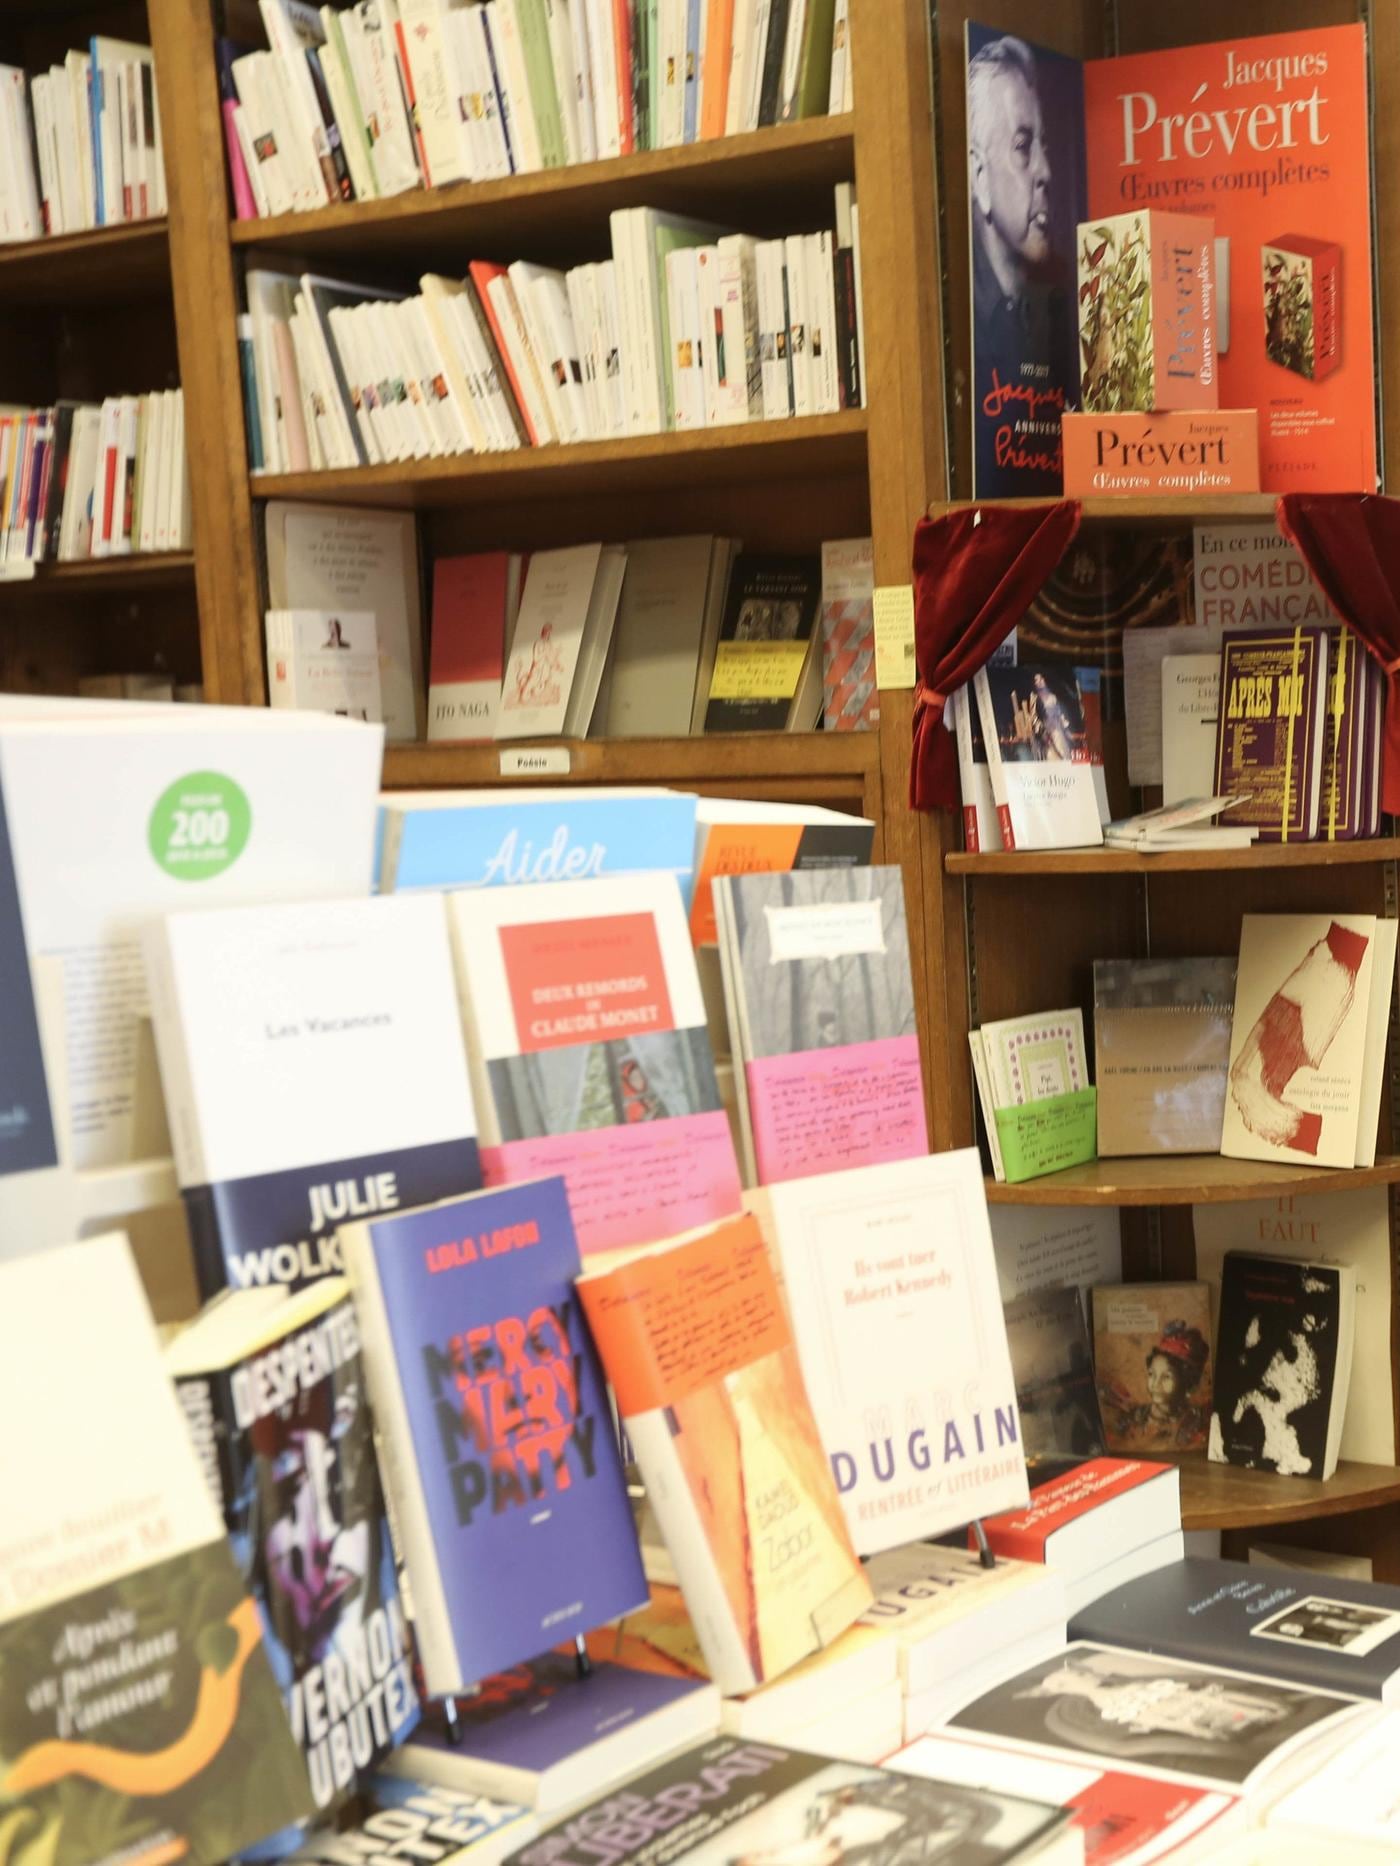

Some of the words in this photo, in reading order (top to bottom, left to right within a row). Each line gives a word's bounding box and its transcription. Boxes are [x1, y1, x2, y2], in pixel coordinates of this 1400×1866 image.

[1223, 51, 1329, 94] Jacques
[1117, 82, 1331, 168] Prévert
[1119, 172, 1206, 200] Œuvres
[1211, 155, 1332, 198] complètes
[1014, 419, 1063, 436] ANNIVERS
[1092, 426, 1232, 468] Prévert
[1093, 471, 1150, 490] Œuvres
[1157, 470, 1232, 493] complètes
[1201, 535, 1224, 555] En
[1229, 536, 1248, 551] ce
[1202, 593, 1331, 626] FRANÇAI
[436, 703, 456, 721] ITO
[459, 702, 491, 717] NAGA
[1228, 676, 1273, 719] APRÈS
[517, 756, 548, 769] Poésie
[1049, 773, 1076, 789] Hugo
[169, 809, 231, 848] 200
[478, 824, 608, 887] Aider
[531, 983, 575, 1005] DEUX
[576, 974, 649, 998] REMORDS
[264, 1022, 300, 1041] Les
[304, 1012, 392, 1034] Vacances
[529, 1013, 598, 1039] CLAUDE
[600, 1004, 658, 1029] MONET
[308, 1172, 399, 1232] JULIE
[425, 1236, 477, 1274] LOLA
[481, 1220, 540, 1259] LAFON
[1257, 1219, 1322, 1244] FAUT
[228, 1234, 346, 1289] WOLK
[908, 1248, 936, 1268] tuer
[843, 1283, 893, 1309] Robert
[895, 1267, 953, 1296] Kennedy
[229, 1302, 361, 1431] DESPENTE
[421, 1302, 573, 1400] MERCY
[434, 1354, 583, 1465] MARY
[830, 1404, 1018, 1495] DUGAIN
[449, 1416, 597, 1529] PATTY
[857, 1482, 924, 1521] RENTRÉE
[946, 1456, 1022, 1495] LITTÉRAIRE
[138, 1516, 171, 1547] M
[306, 1661, 420, 1809] UBUTE
